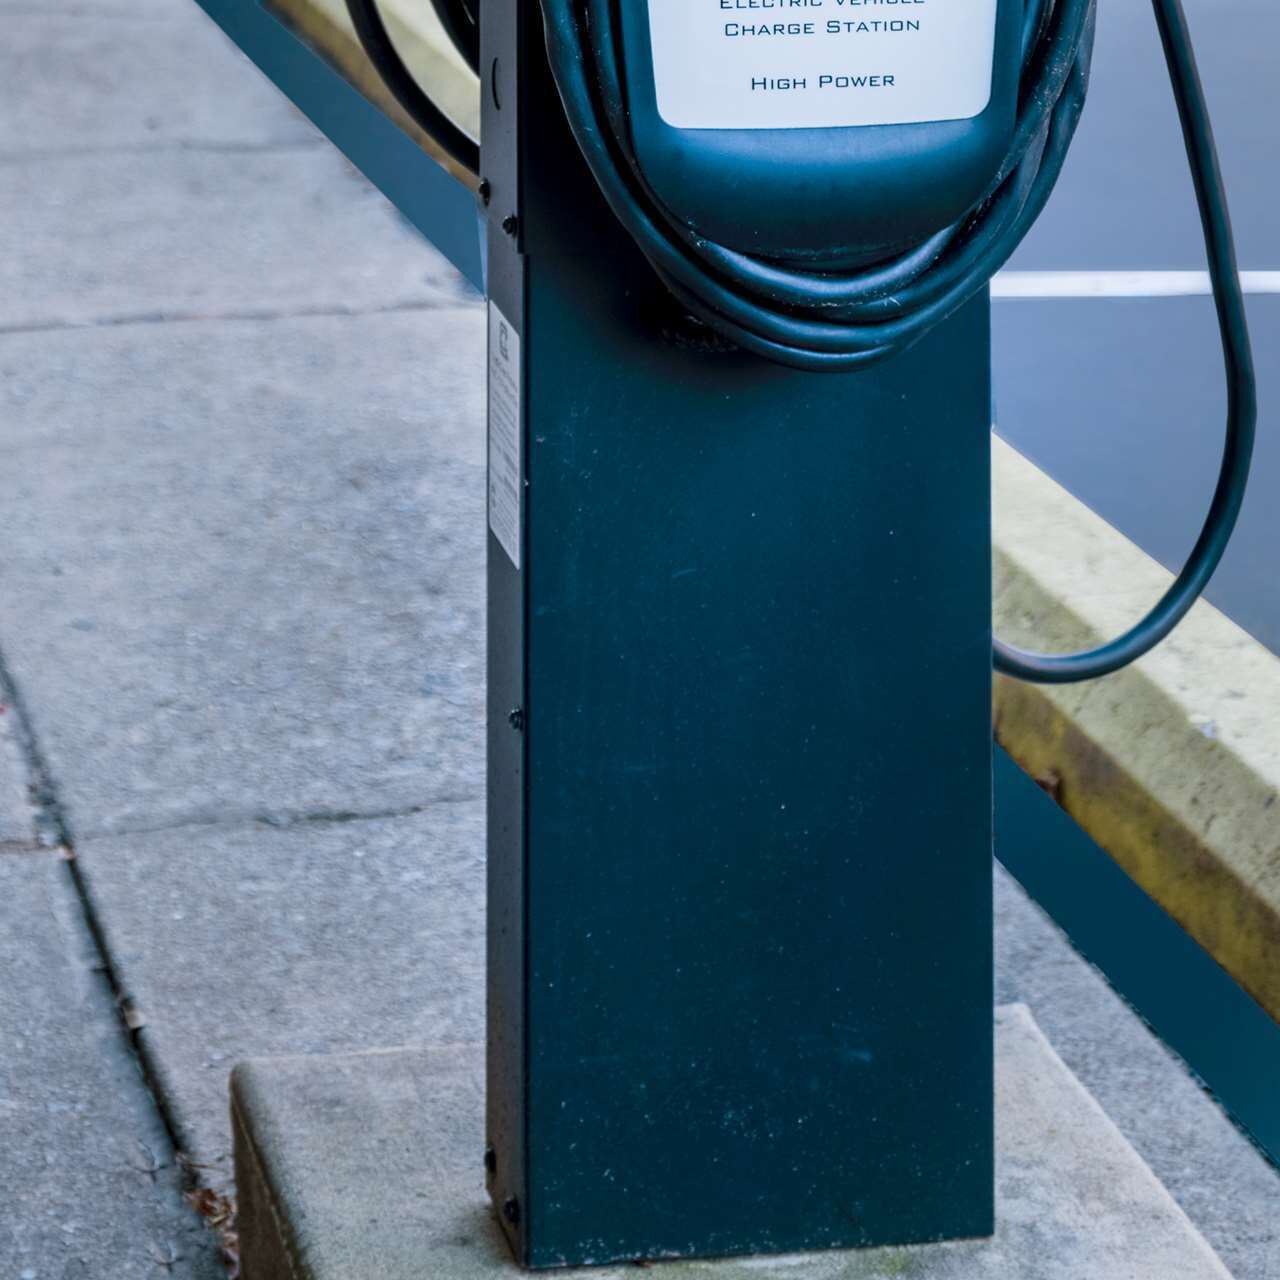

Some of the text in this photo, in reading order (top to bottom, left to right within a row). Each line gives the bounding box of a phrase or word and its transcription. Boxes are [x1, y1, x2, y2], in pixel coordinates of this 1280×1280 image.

[724, 19, 920, 37] CHARGE STATION
[751, 74, 895, 91] HIGH POWER
